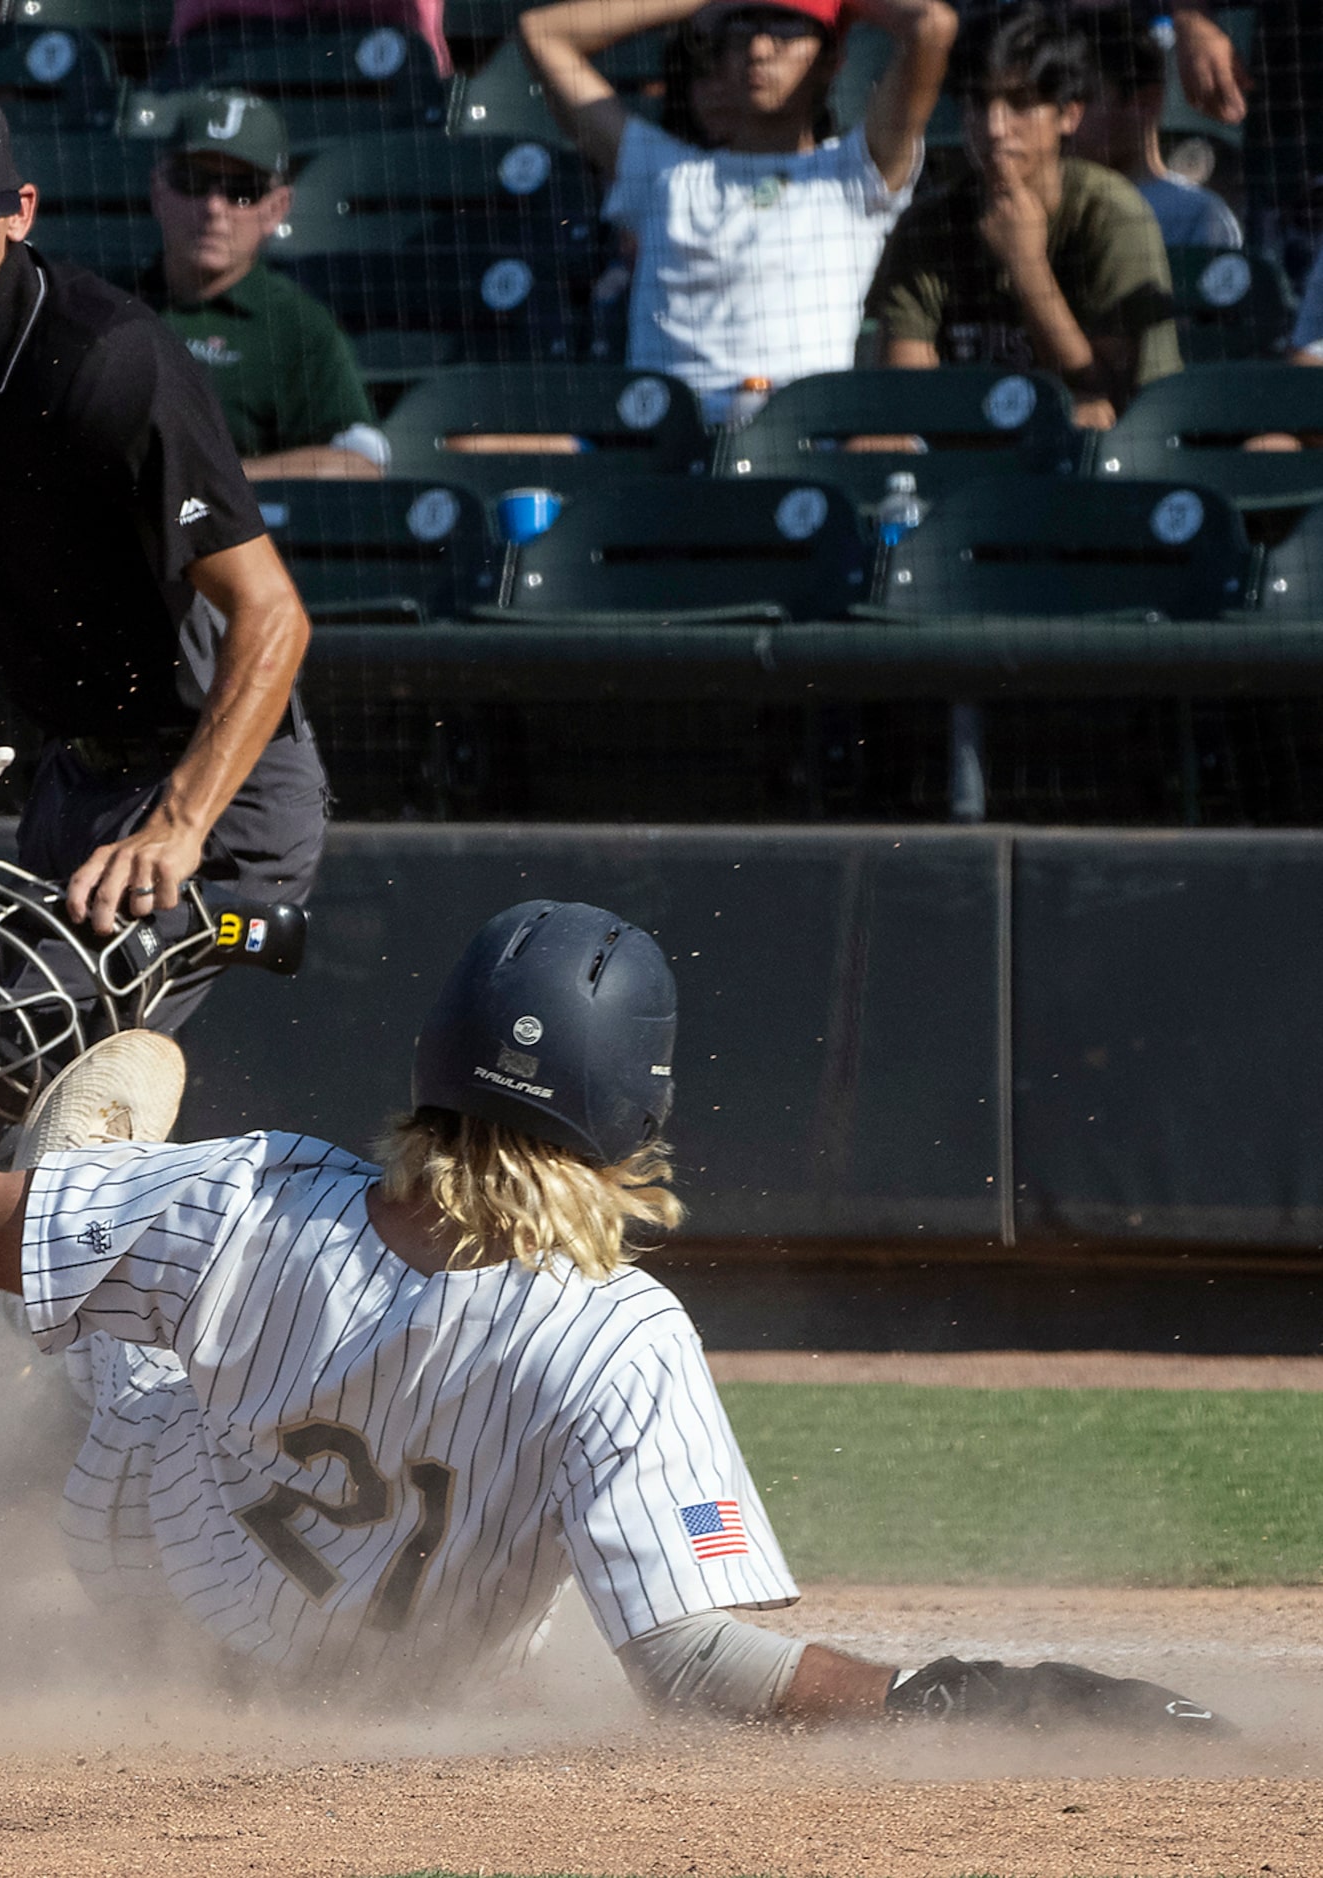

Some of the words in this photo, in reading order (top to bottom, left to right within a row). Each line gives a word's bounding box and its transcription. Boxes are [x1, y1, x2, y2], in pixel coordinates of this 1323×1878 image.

[207, 94, 252, 139] J
[474, 1066, 555, 1099] RAWLINGS
[233, 1416, 458, 1634] 21
